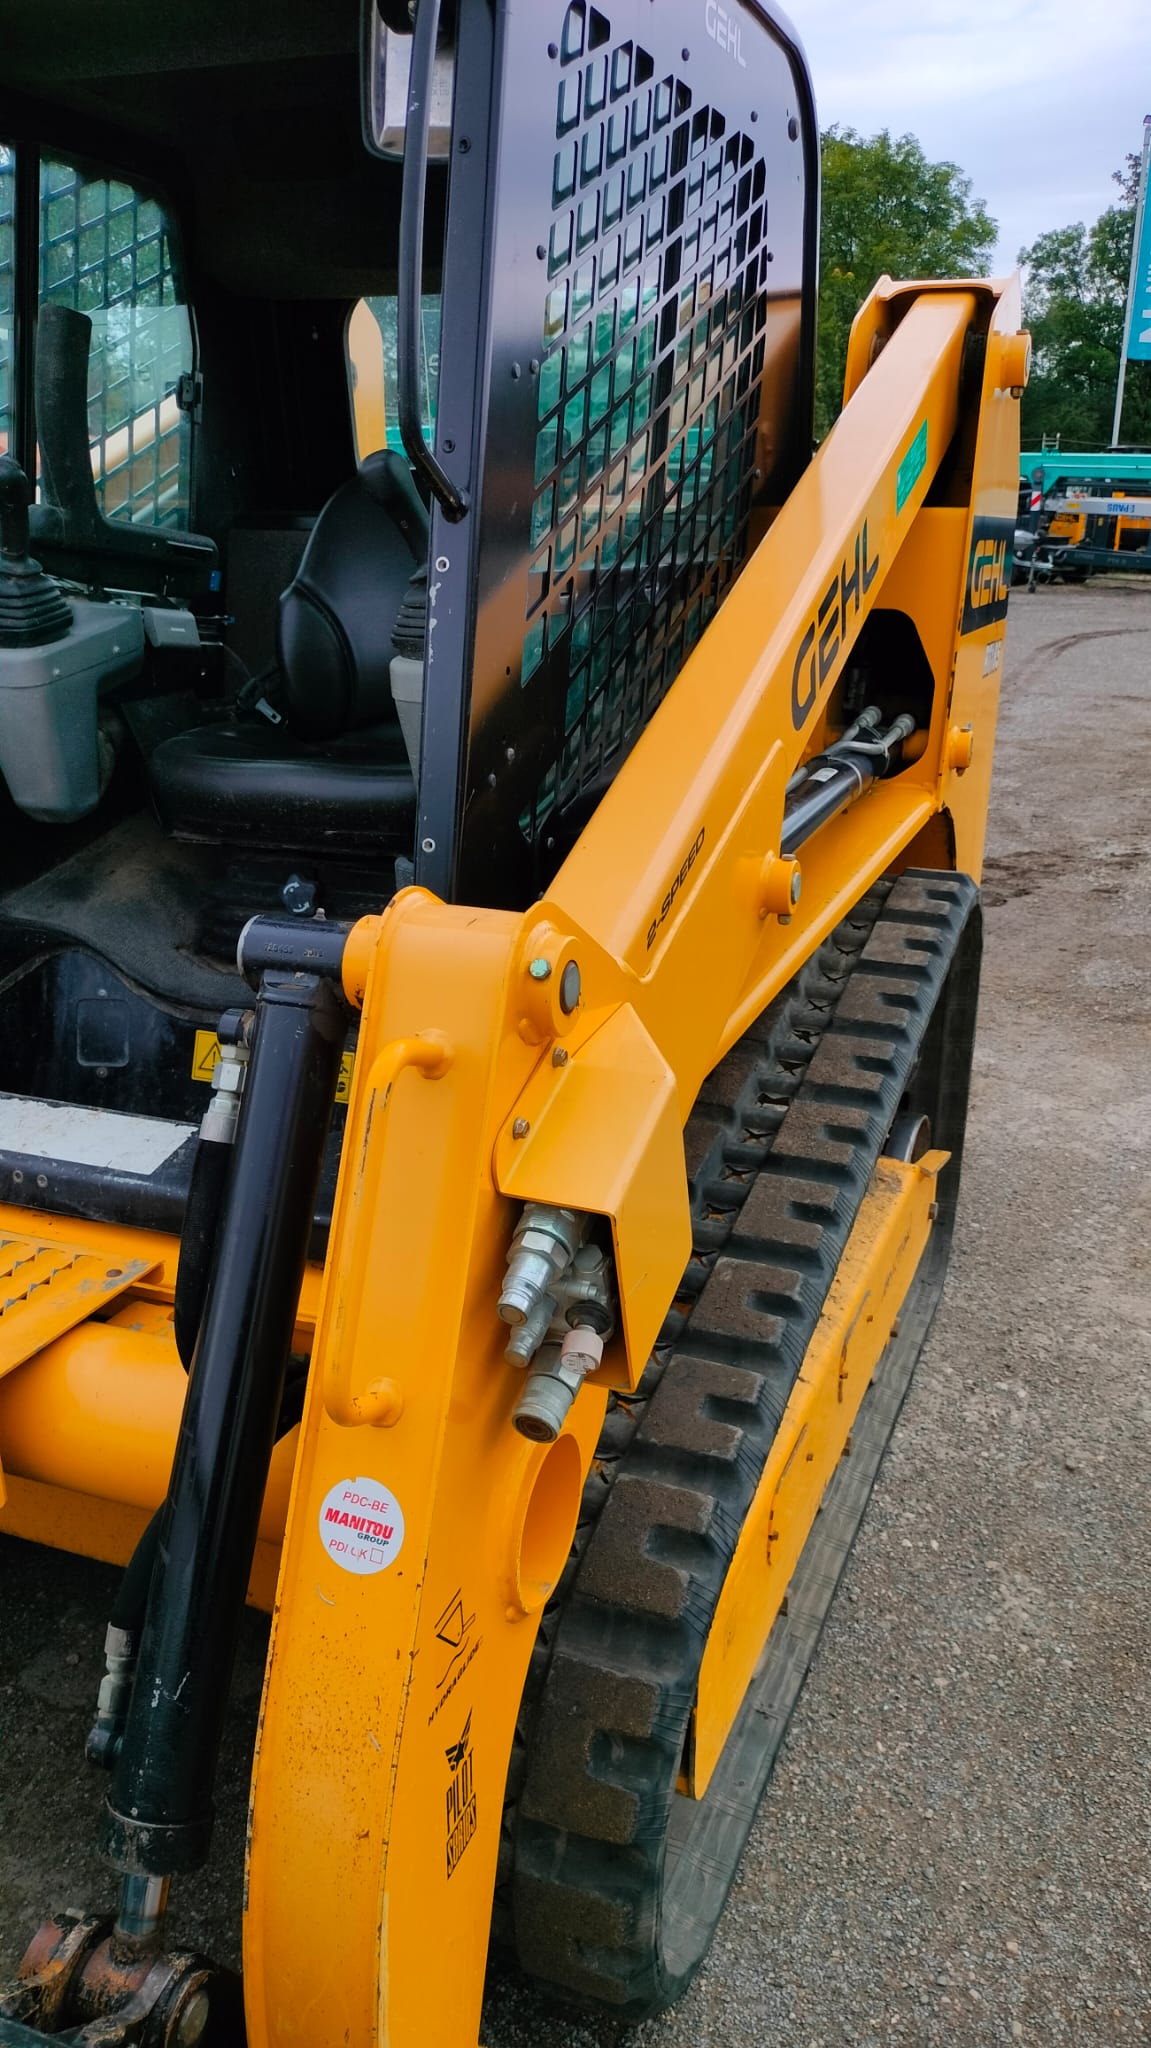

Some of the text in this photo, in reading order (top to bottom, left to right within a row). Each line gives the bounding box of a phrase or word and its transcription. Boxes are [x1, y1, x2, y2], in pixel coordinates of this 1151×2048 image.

[705, 0, 746, 68] GEHL
[970, 539, 1008, 609] GEHL
[791, 516, 879, 732] GEHL
[647, 826, 705, 952] 2-SPEED
[324, 1507, 394, 1540] MANITOU
[343, 1491, 390, 1514] PDC-BE
[328, 1539, 348, 1554] PDI
[357, 1532, 389, 1547] GROUP
[446, 1747, 474, 1836] PILOT
